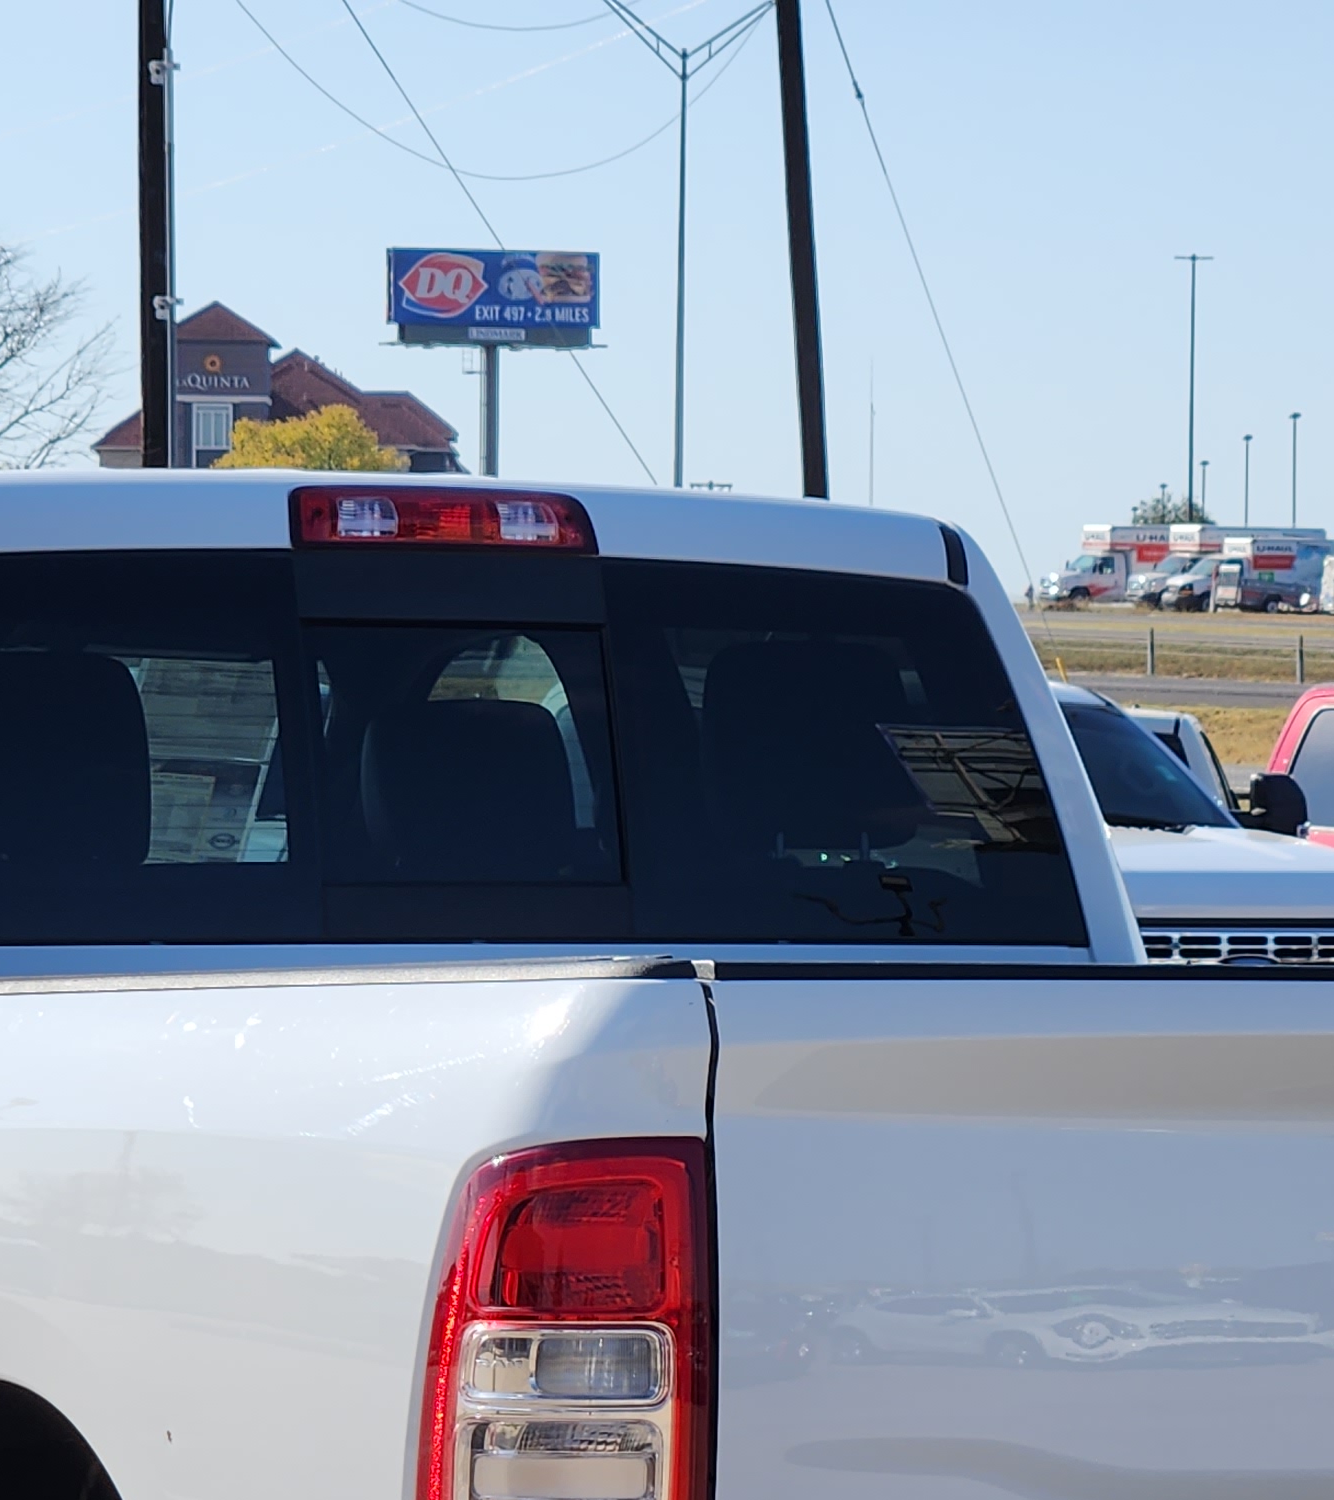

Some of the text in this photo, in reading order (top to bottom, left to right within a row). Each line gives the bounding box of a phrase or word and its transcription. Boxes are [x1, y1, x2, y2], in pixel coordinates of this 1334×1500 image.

[417, 267, 473, 303] DQ
[475, 305, 499, 320] EXIT
[504, 306, 524, 320] 497
[555, 307, 589, 322] MILES
[187, 373, 250, 390] QUINTA
